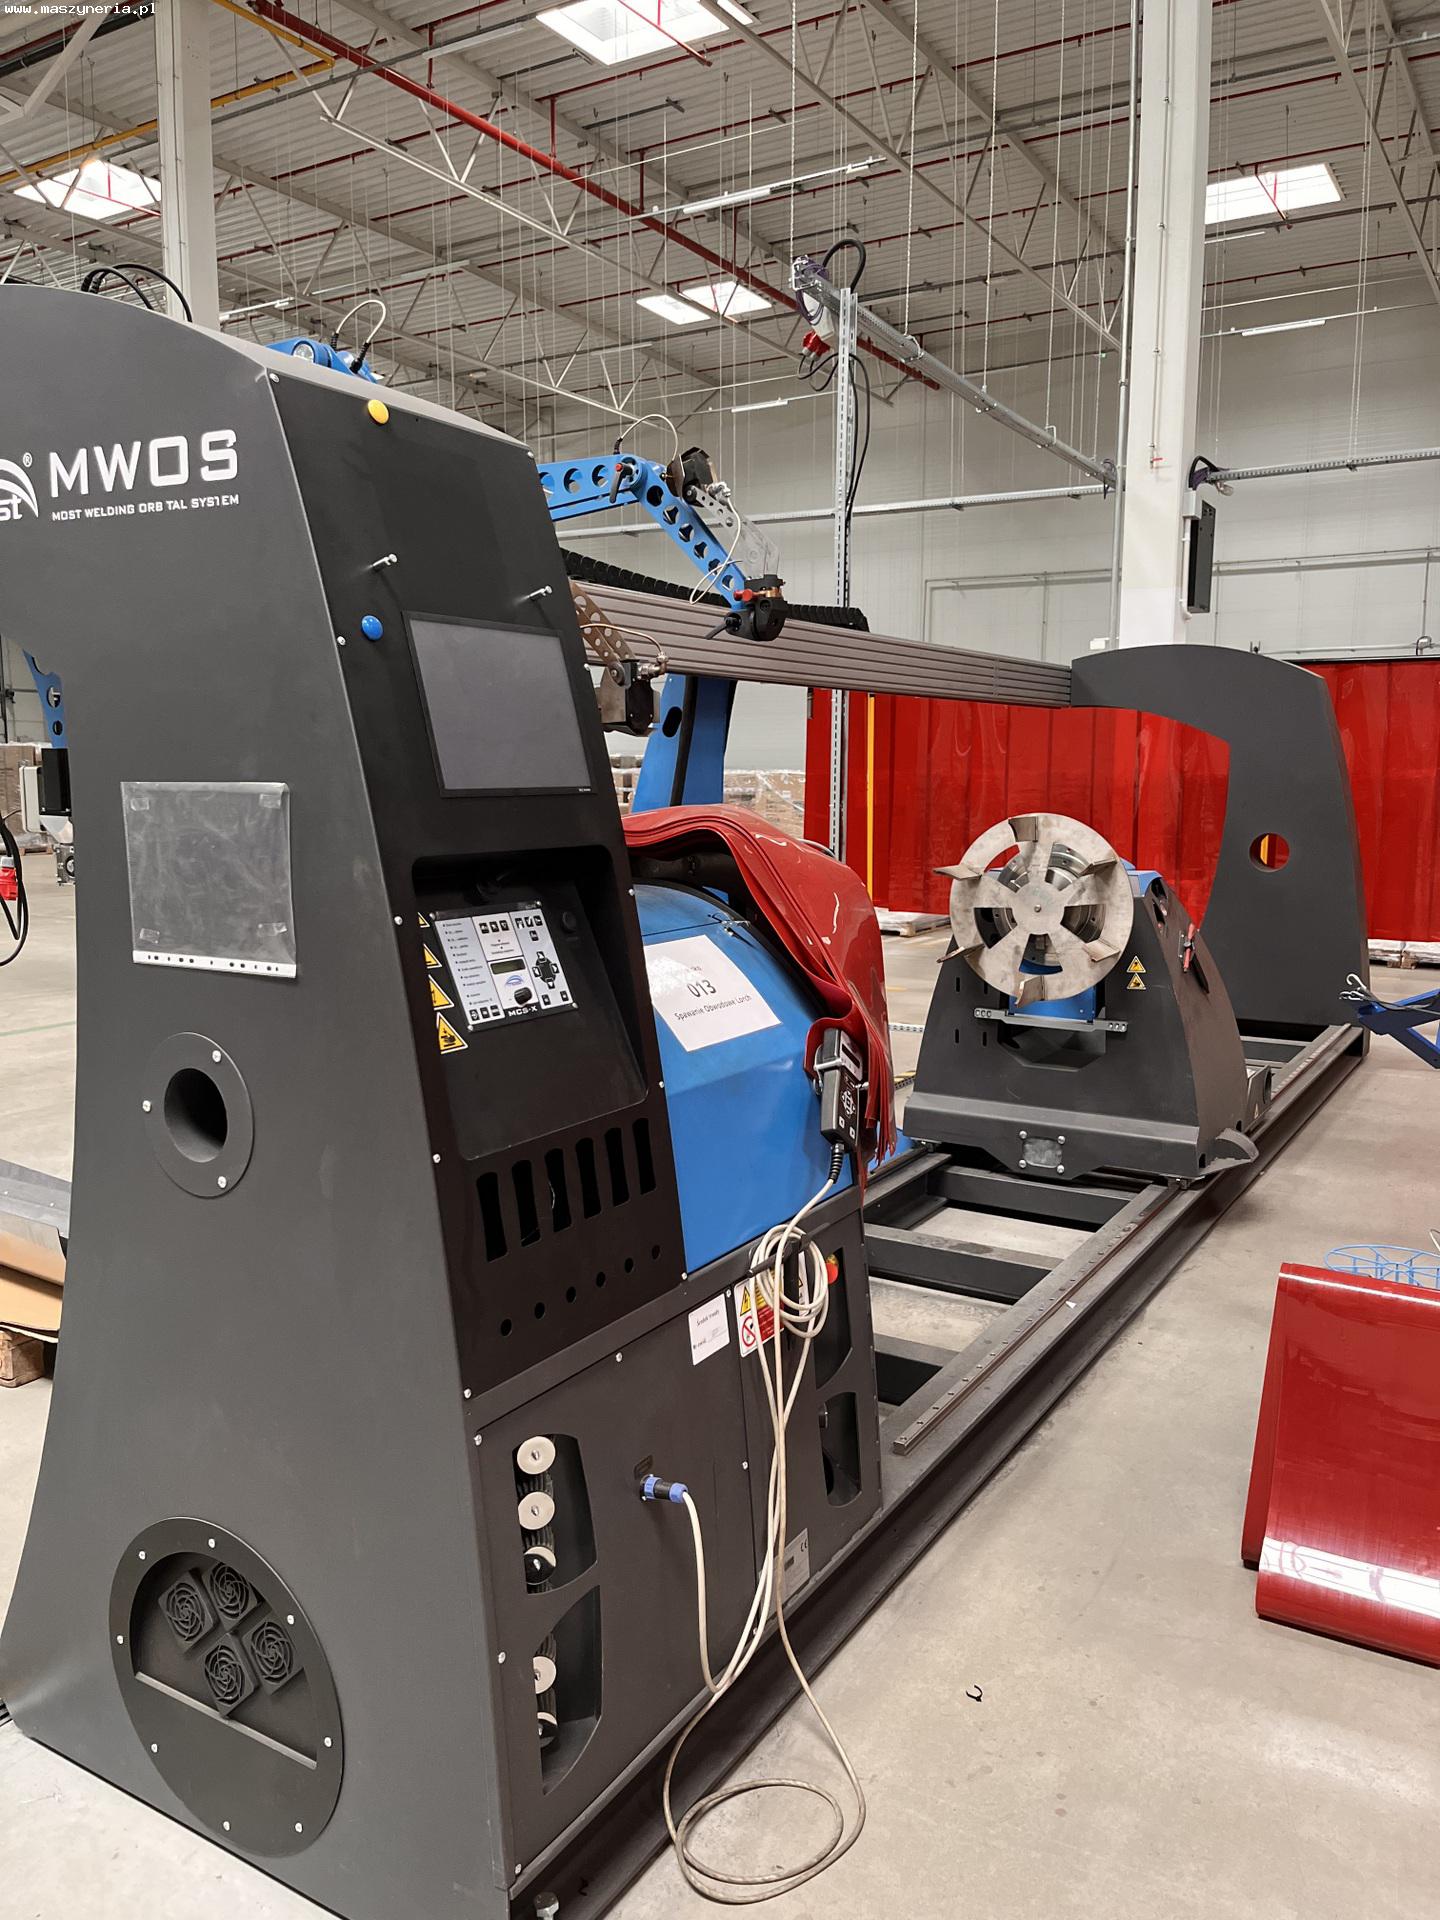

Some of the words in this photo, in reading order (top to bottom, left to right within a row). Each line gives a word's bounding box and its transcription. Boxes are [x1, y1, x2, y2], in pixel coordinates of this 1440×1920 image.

[49, 429, 239, 498] MWOS
[52, 509, 83, 522] MOST
[85, 503, 135, 518] WELDING
[686, 979, 717, 998] 013
